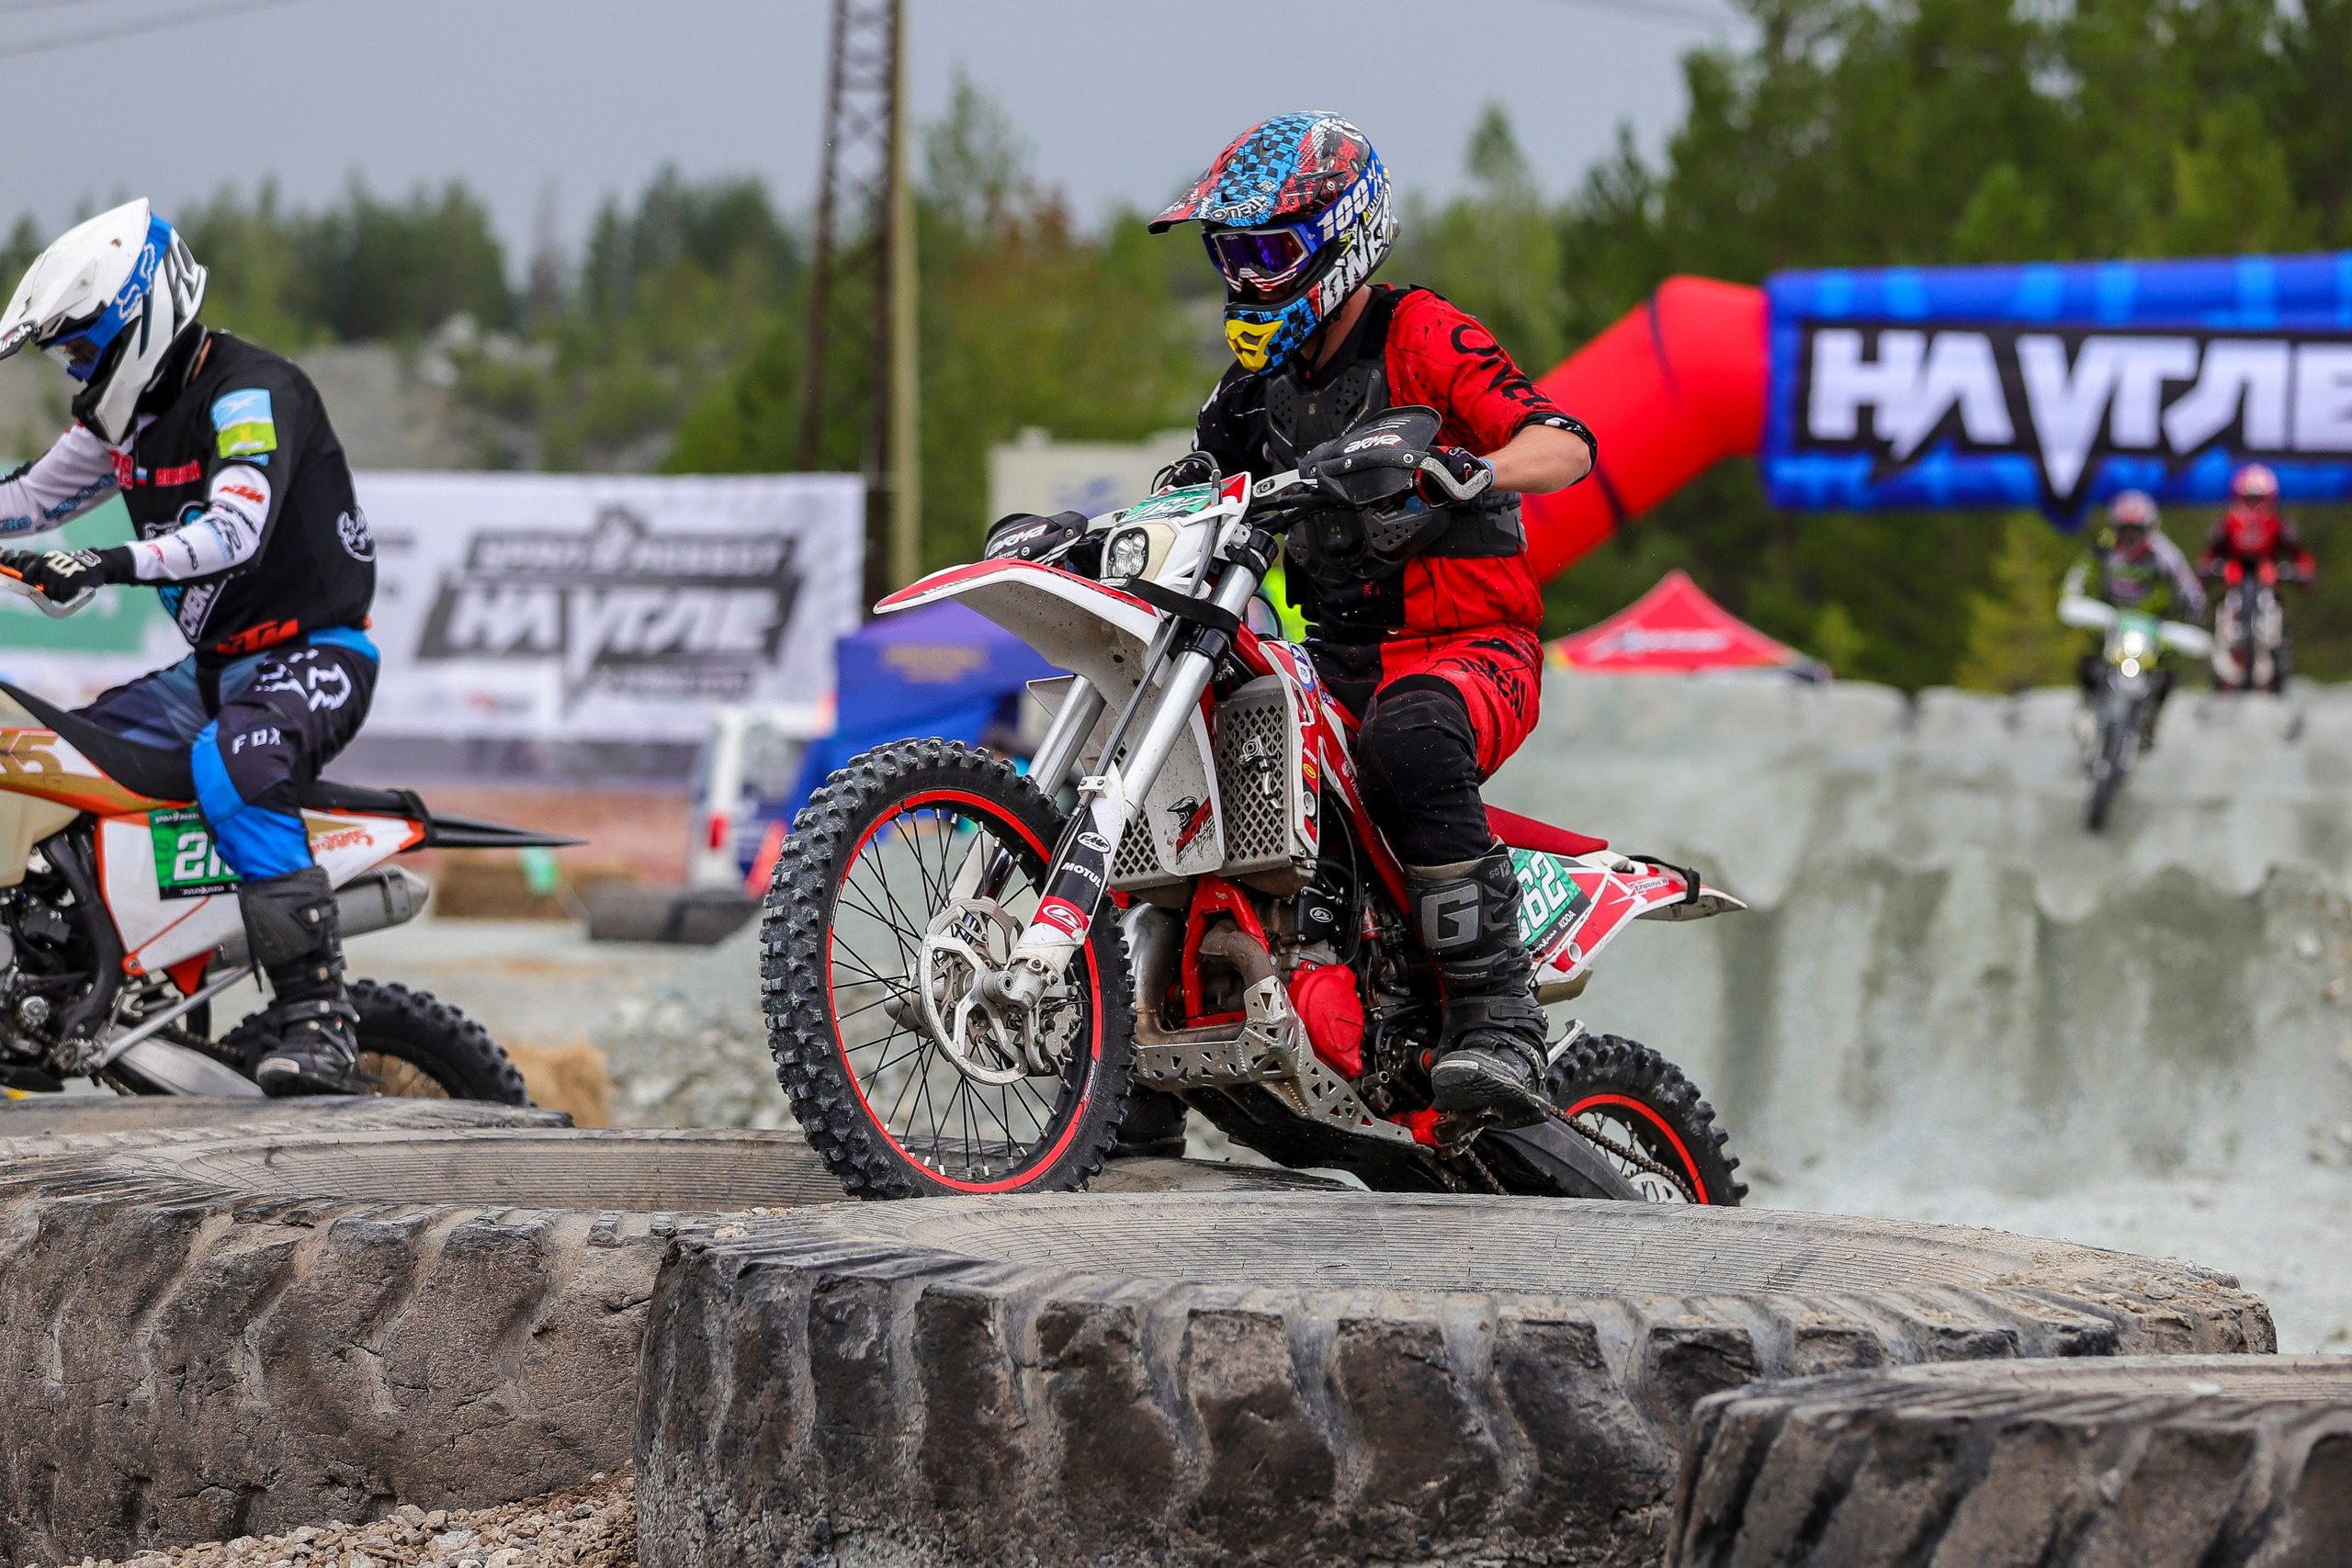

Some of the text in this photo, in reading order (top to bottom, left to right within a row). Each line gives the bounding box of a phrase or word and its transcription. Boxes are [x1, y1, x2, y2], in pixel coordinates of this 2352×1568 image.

[215, 618, 300, 655] KTM
[232, 726, 281, 755] FOX
[1060, 862, 1102, 888] MOTUL
[1557, 910, 1577, 930] KODA
